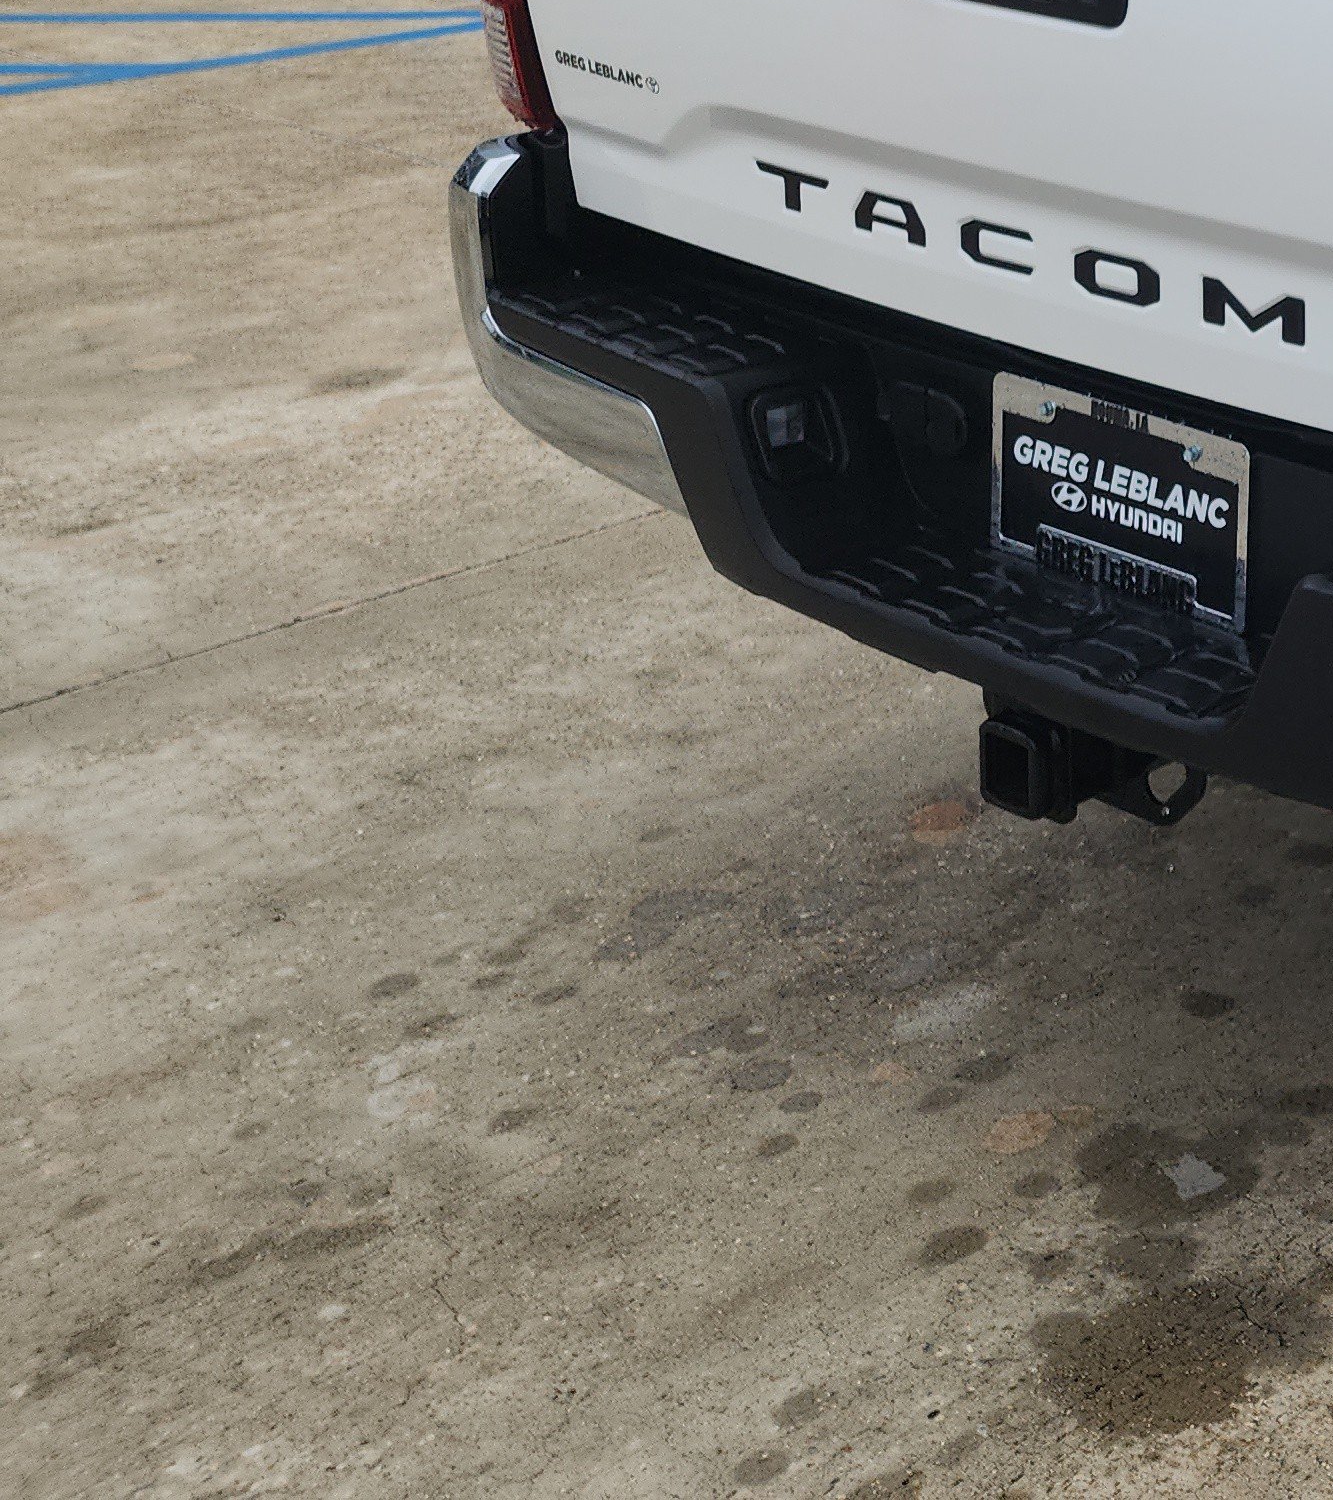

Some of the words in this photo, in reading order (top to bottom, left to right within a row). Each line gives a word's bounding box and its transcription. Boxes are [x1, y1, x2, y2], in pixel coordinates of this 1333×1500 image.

[555, 49, 586, 71] GREG
[588, 58, 643, 89] LEBLANC
[1013, 435, 1089, 482] GREG
[1093, 460, 1229, 528] LEBLANC
[1091, 494, 1183, 544] HYUNDAI
